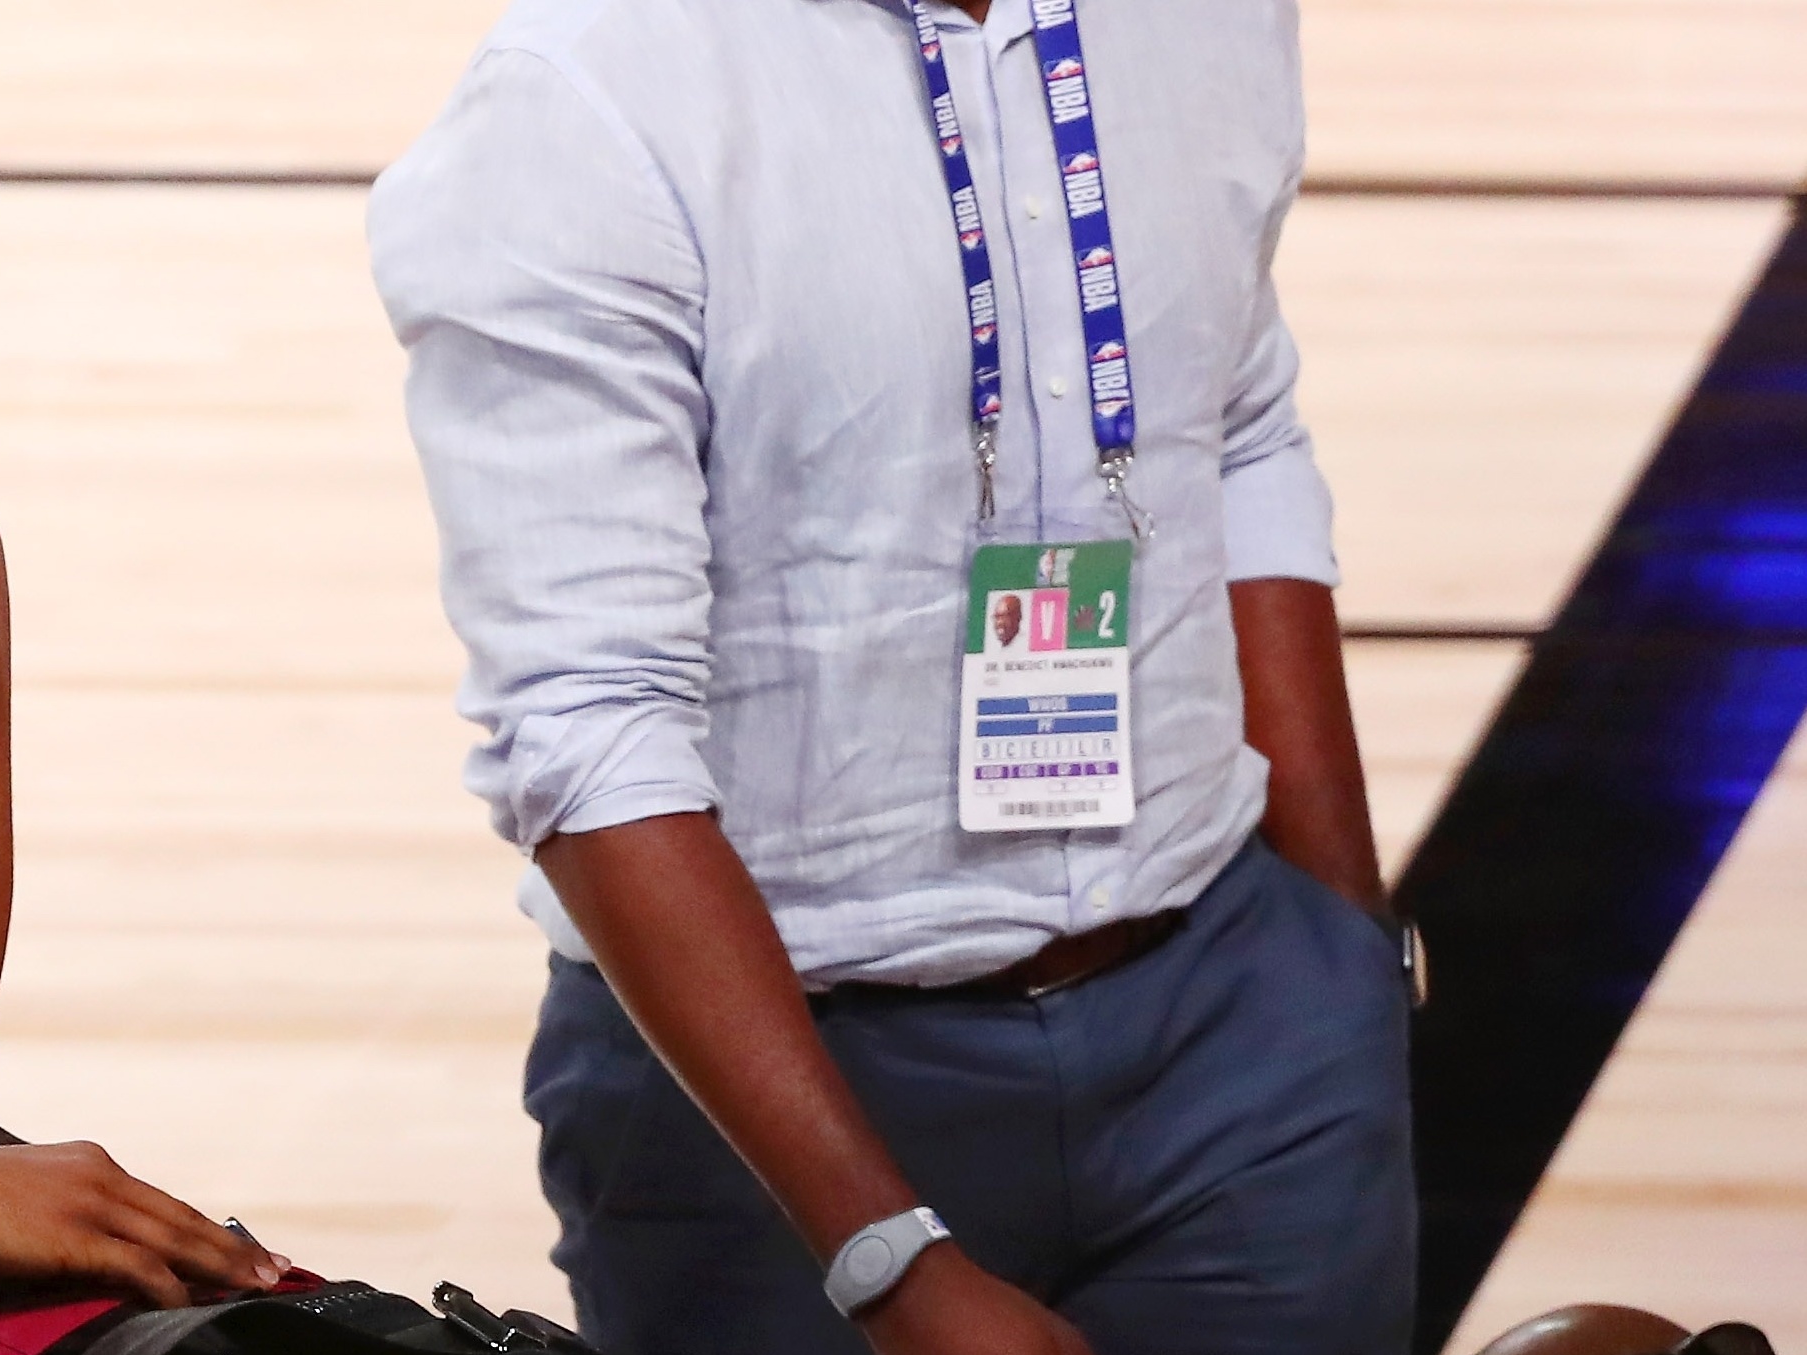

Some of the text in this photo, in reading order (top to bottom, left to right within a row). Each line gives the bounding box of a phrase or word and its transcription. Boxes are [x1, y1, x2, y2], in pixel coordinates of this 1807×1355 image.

[1033, 0, 1074, 29] BA
[933, 92, 960, 138] NBA
[1047, 75, 1089, 123] NBA
[952, 185, 982, 232] NBA
[1063, 171, 1104, 219] NBA
[969, 279, 995, 327] NBA
[1079, 264, 1119, 313] NBA
[1098, 590, 1117, 639] 2
